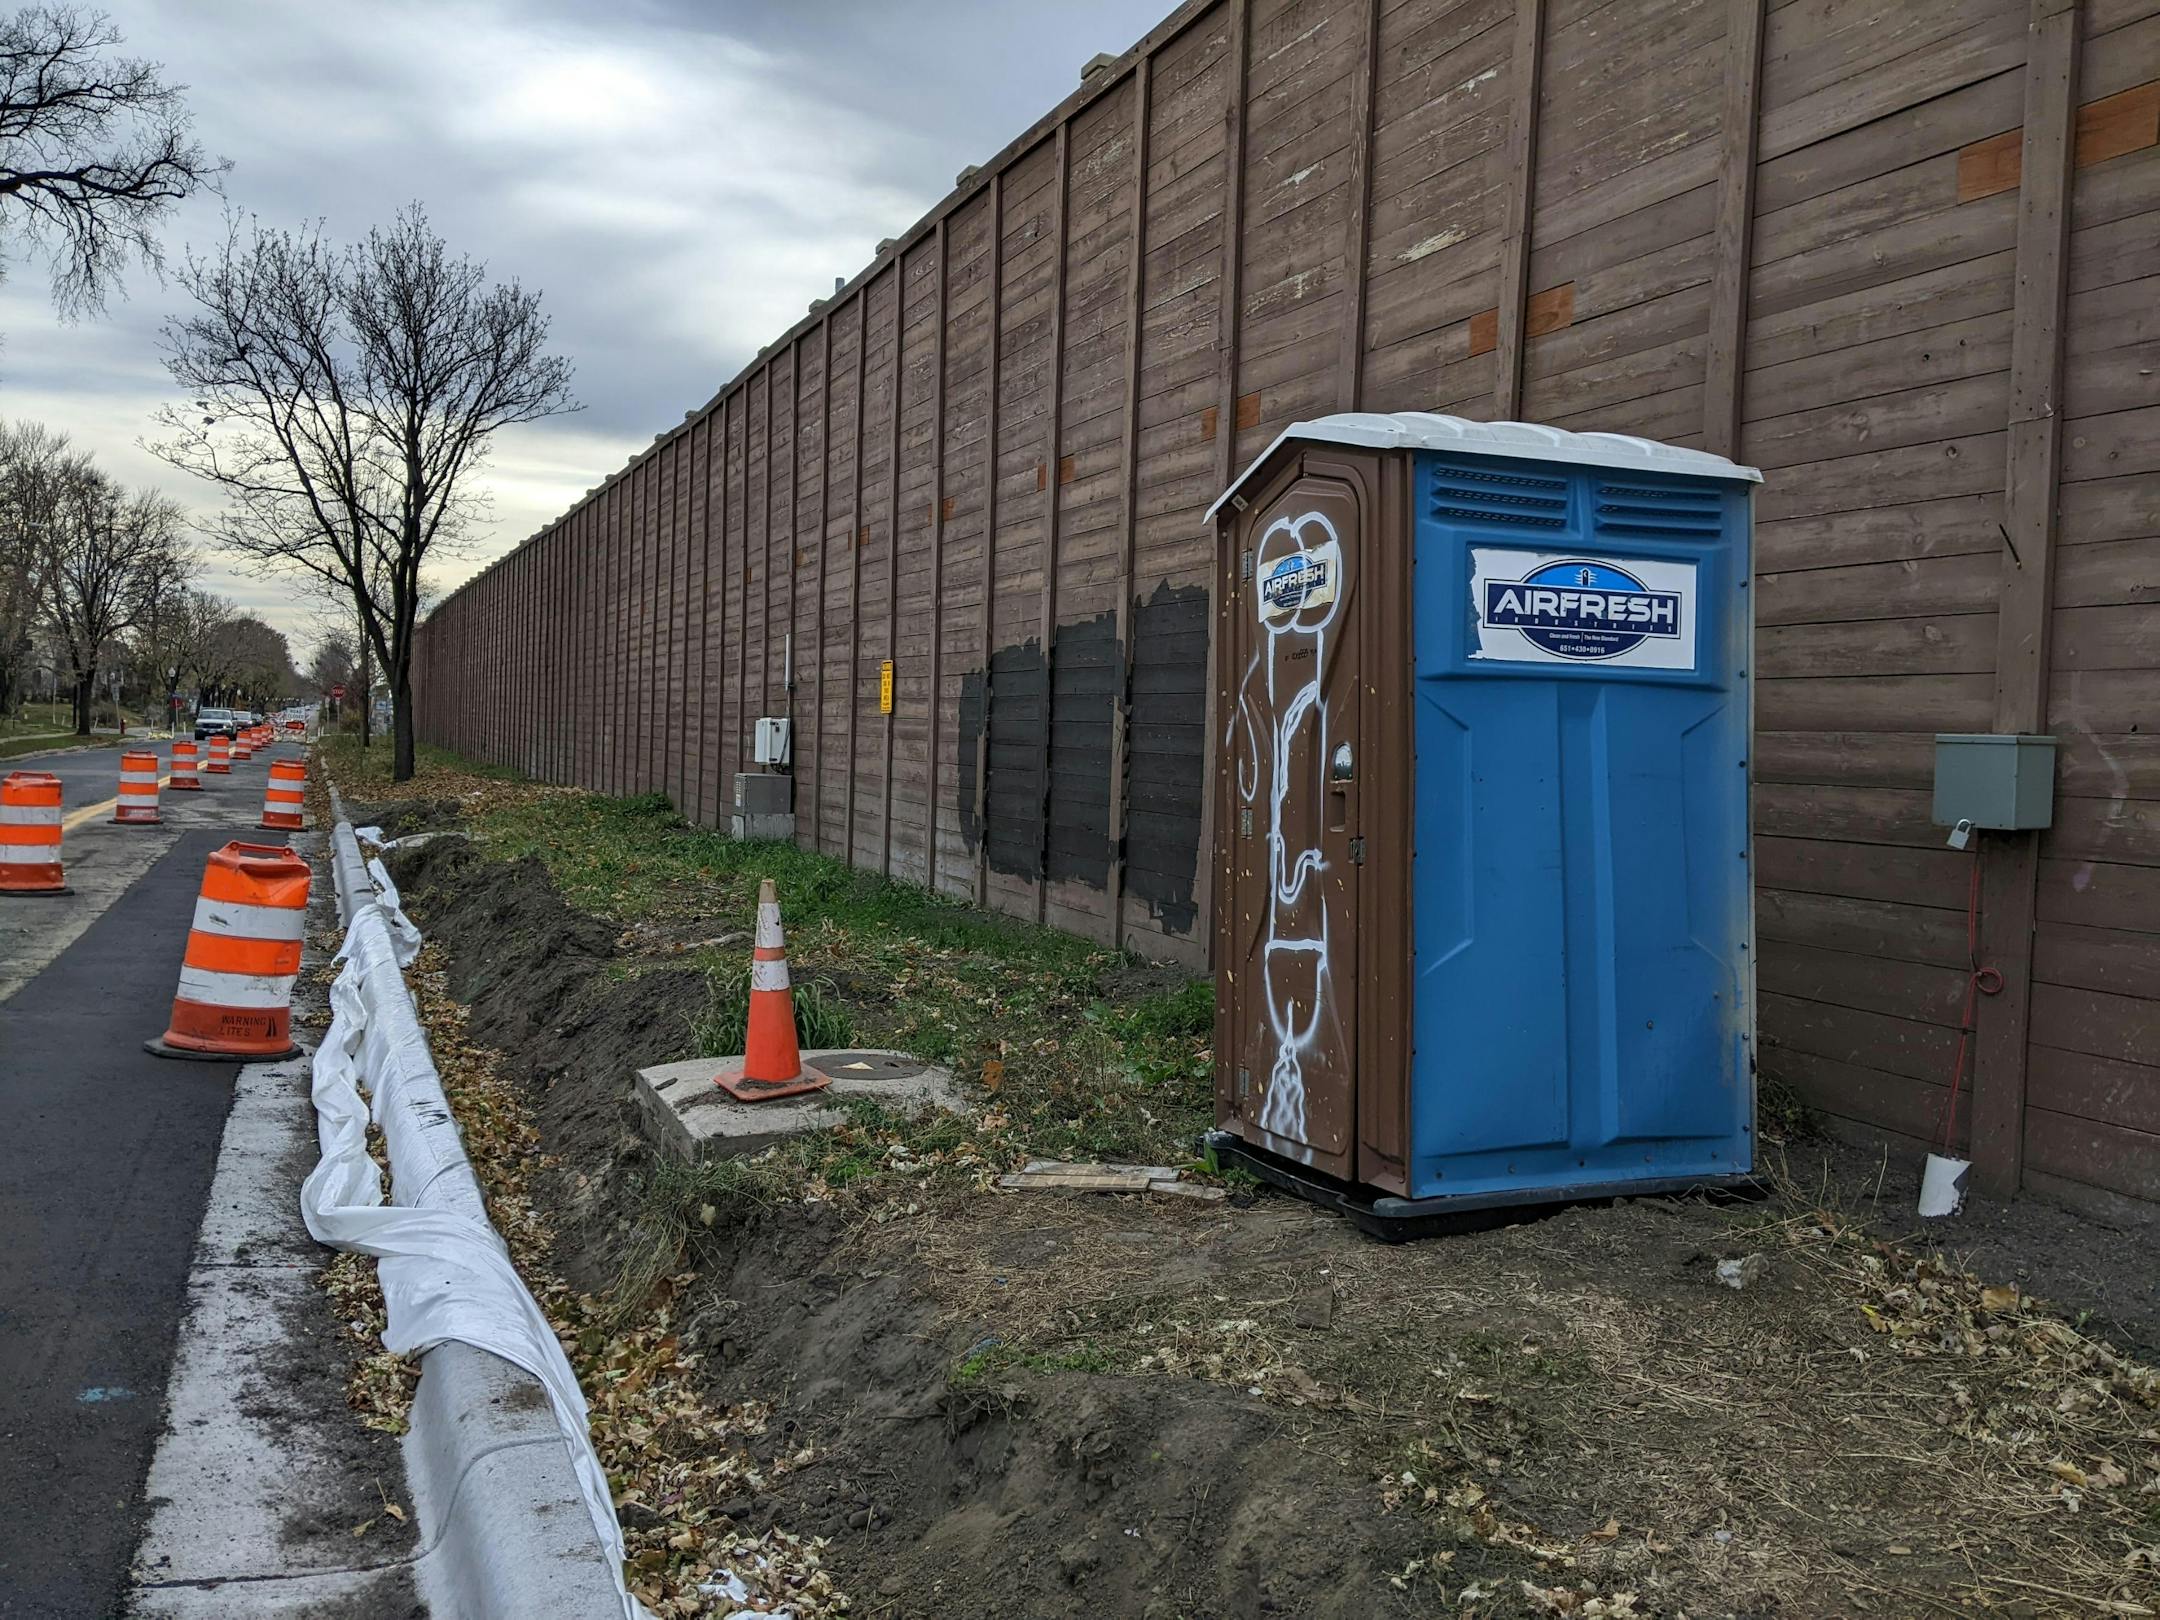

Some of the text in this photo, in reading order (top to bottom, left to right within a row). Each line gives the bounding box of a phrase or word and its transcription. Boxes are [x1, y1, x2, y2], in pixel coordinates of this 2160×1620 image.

[1493, 588, 1674, 625] AIRFRESH
[222, 1015, 266, 1026] WARNING
[218, 1026, 251, 1037] LITES
